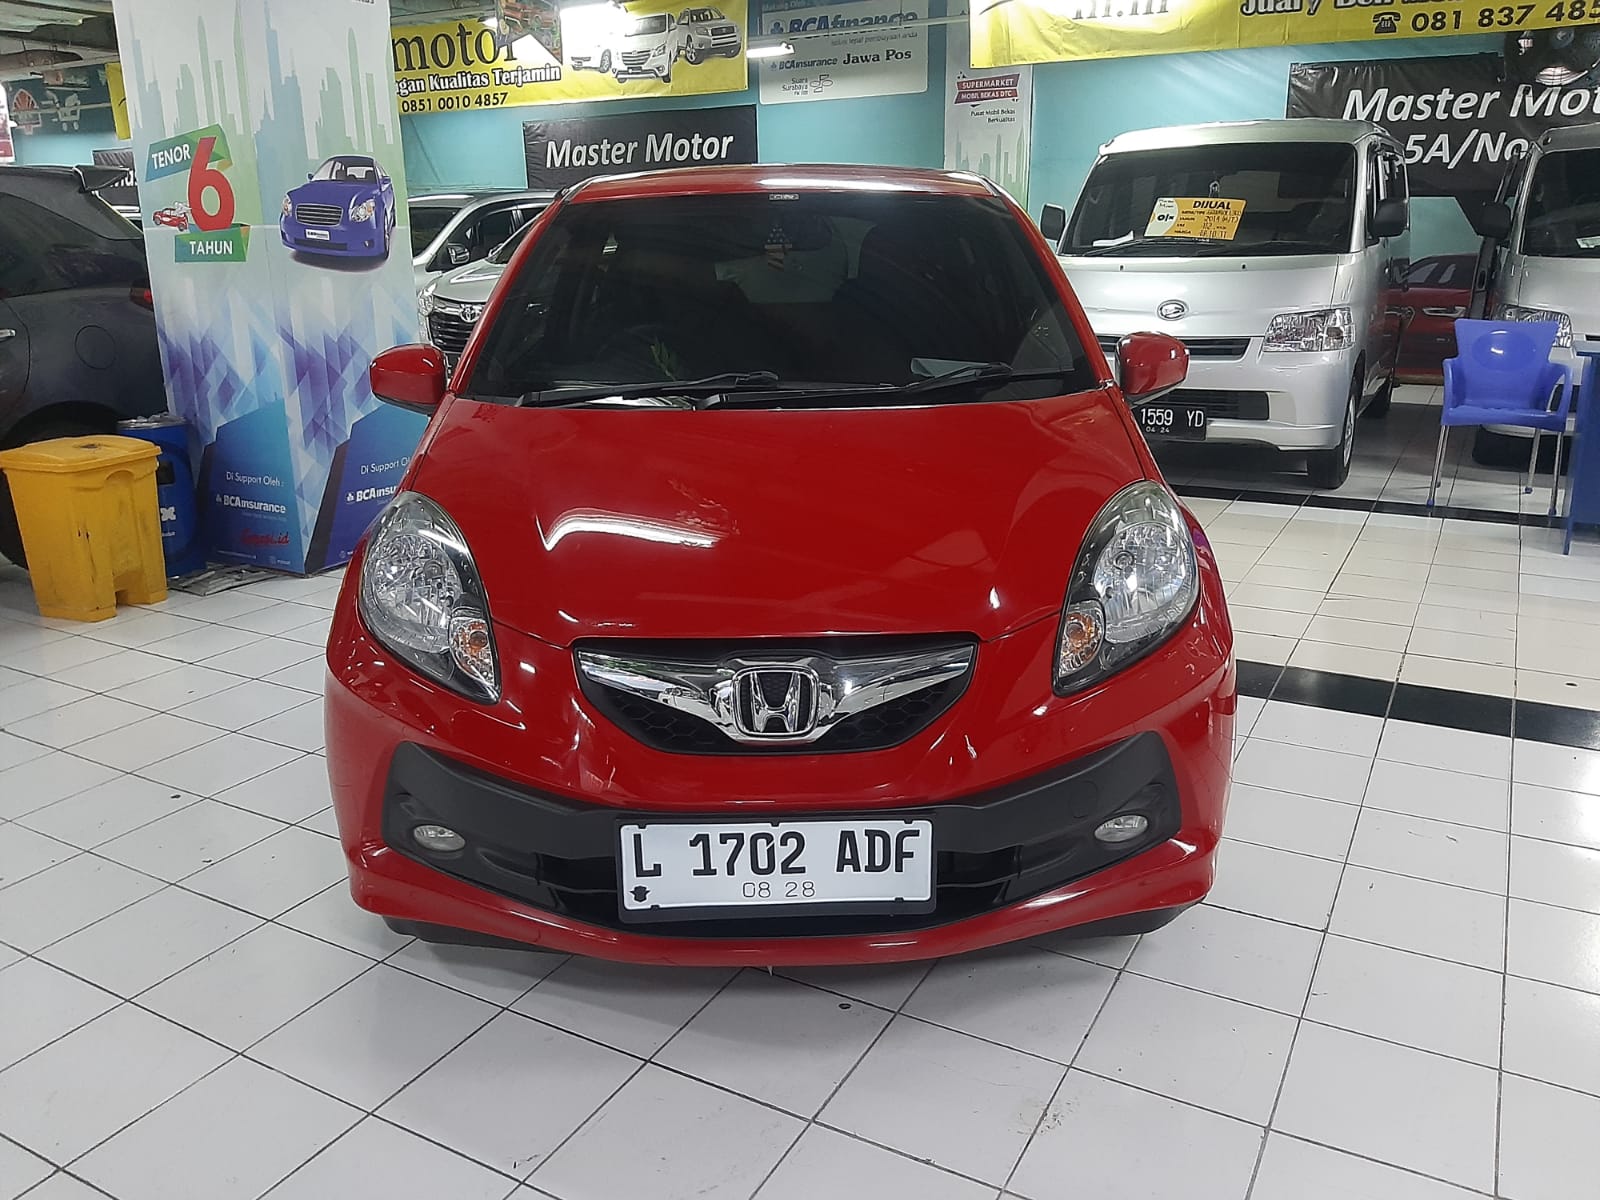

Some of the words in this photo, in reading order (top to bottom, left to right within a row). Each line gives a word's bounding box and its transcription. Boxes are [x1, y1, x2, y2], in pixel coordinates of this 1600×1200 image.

[1411, 10, 1462, 32] 081
[1477, 4, 1536, 27] 837
[843, 53, 880, 65] Jawa
[885, 49, 912, 61] Pos
[428, 71, 489, 92] Kualitas
[491, 62, 561, 87] Terjamin
[962, 78, 1014, 89] SUPERMARKET
[401, 98, 432, 113] 0851
[438, 95, 471, 110] 0010
[475, 92, 508, 106] 4857
[1342, 87, 1501, 122] Master
[151, 143, 192, 170] TENOR
[546, 138, 638, 169] Master
[645, 132, 734, 162] Motor
[188, 136, 235, 232] 6
[1193, 200, 1231, 210] DIJUAL
[189, 240, 233, 255] TAHUN
[1141, 408, 1173, 426] 1559
[1187, 410, 1204, 427] YD
[360, 465, 369, 475] Di
[371, 460, 399, 472] Support
[235, 472, 261, 485] Support
[633, 833, 663, 878] L
[689, 831, 806, 877] 1702
[835, 828, 921, 873] ADF
[742, 881, 771, 898] 08
[785, 881, 815, 898] 28
